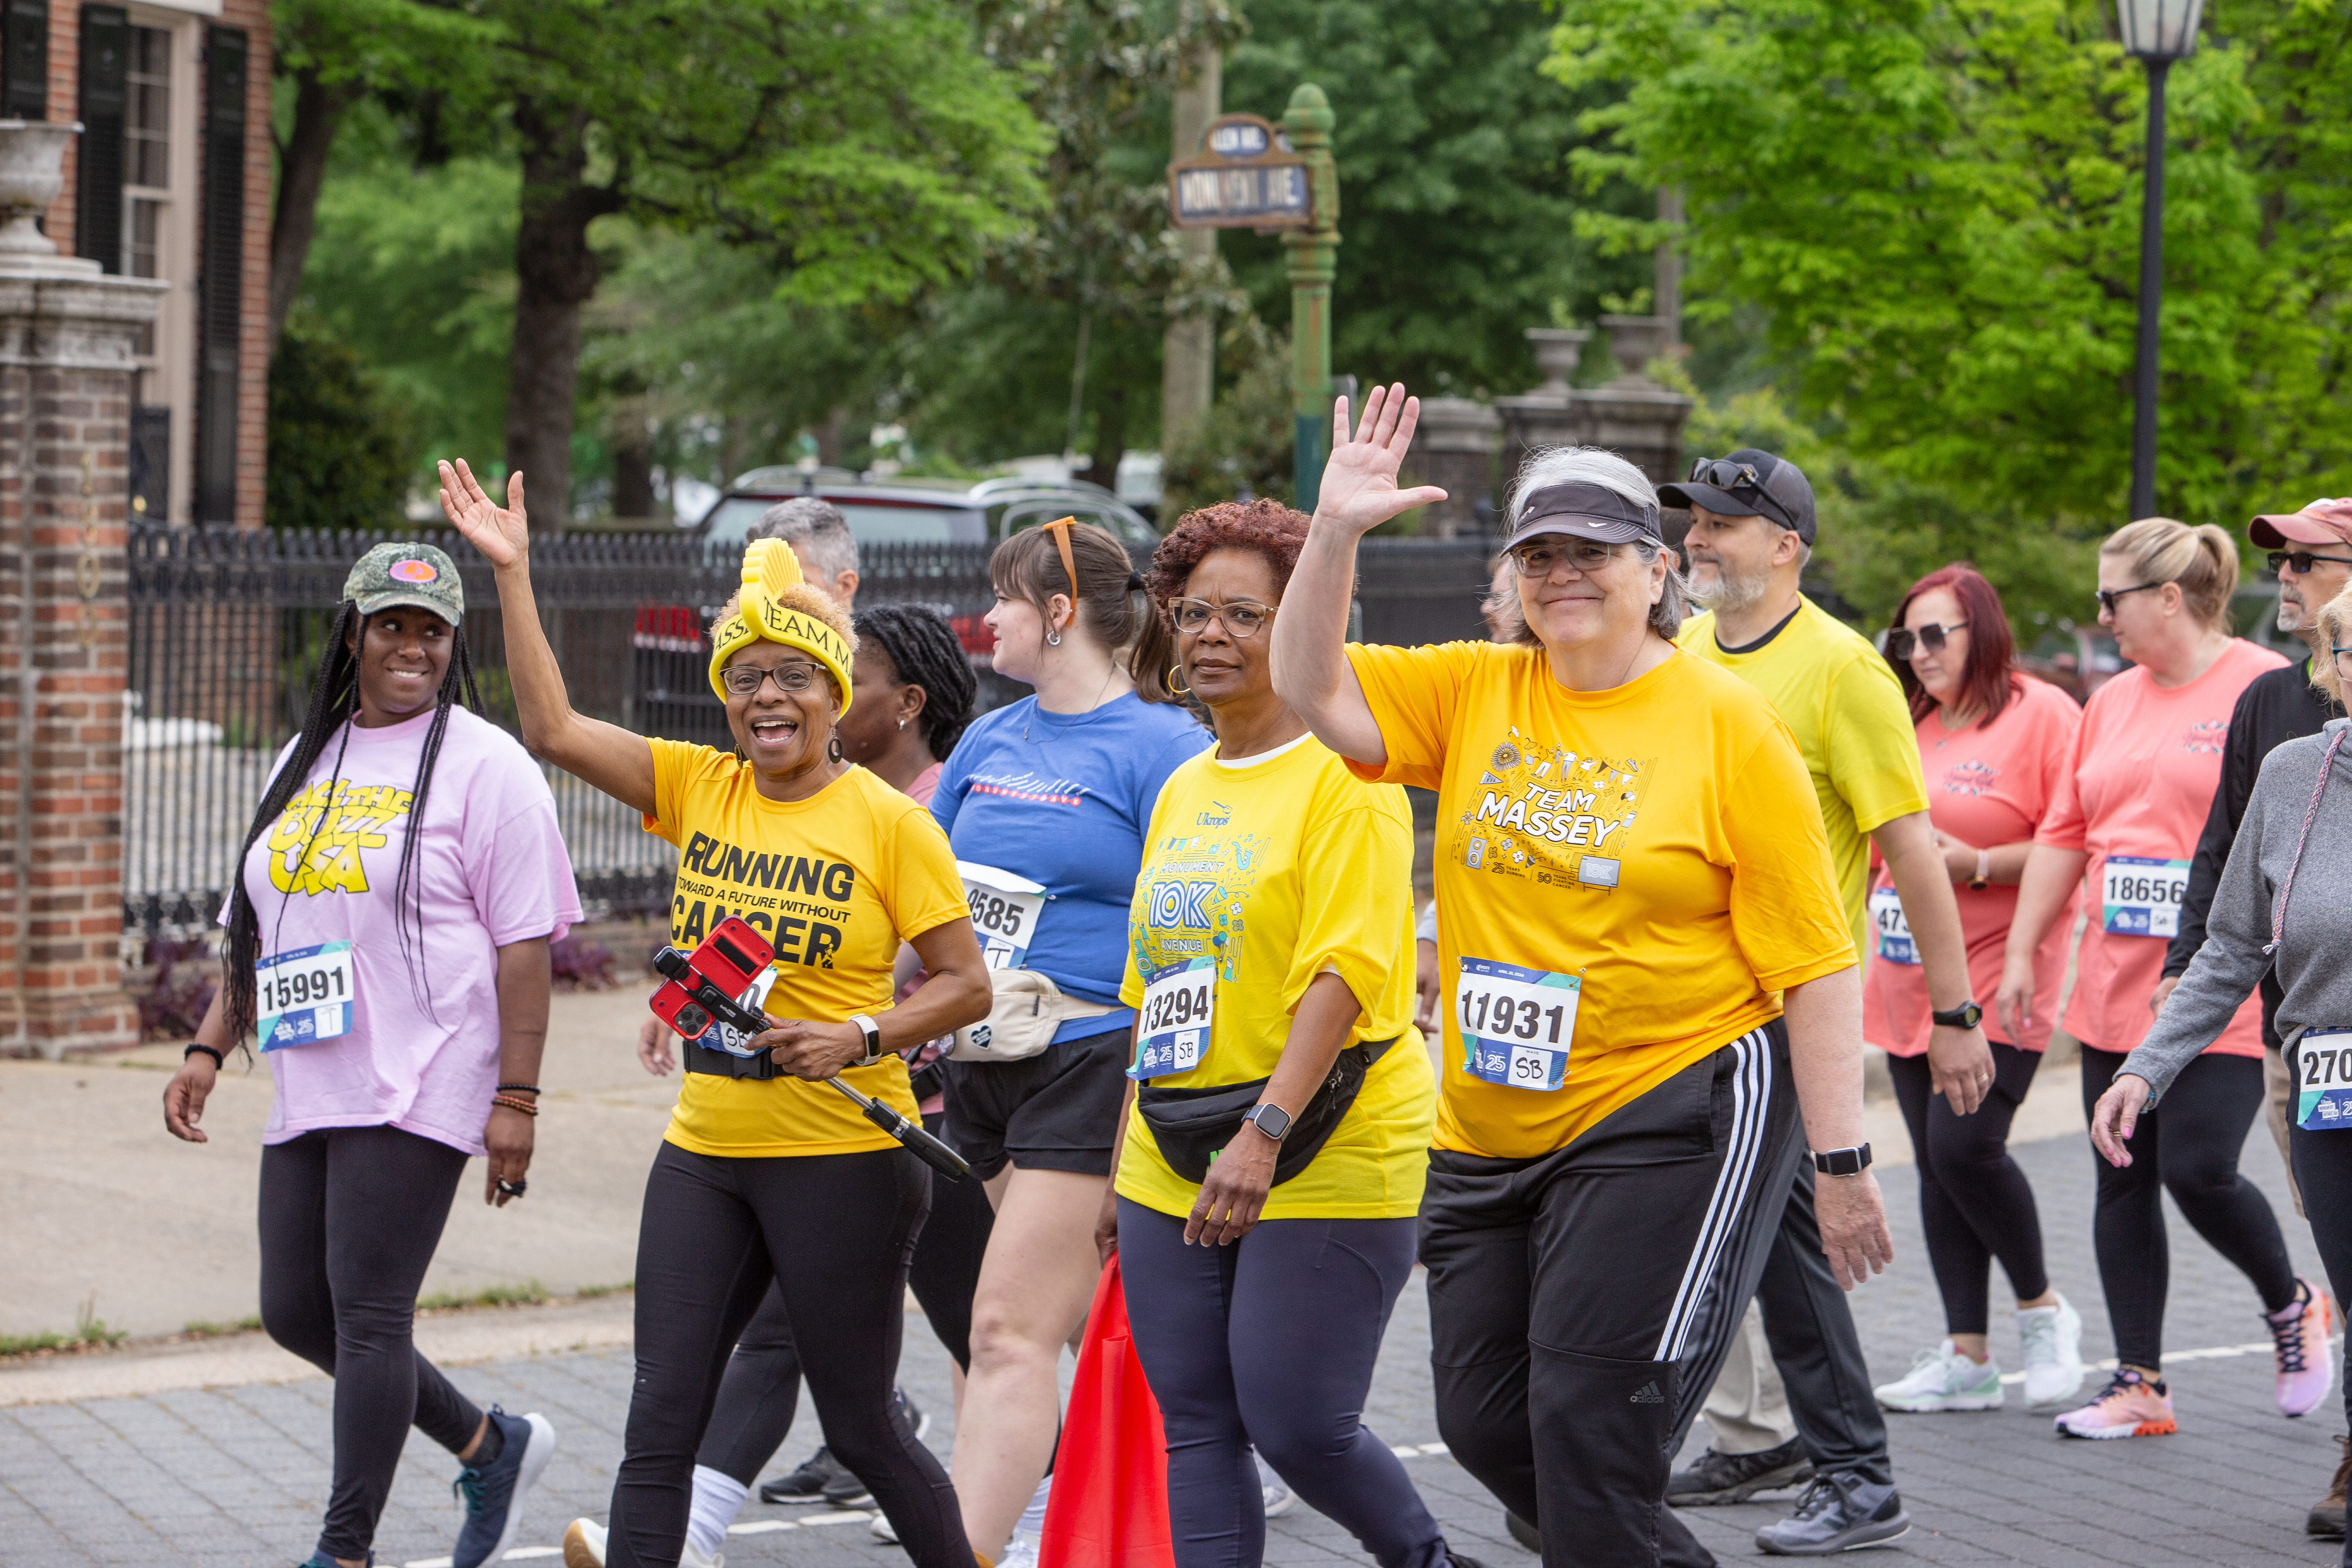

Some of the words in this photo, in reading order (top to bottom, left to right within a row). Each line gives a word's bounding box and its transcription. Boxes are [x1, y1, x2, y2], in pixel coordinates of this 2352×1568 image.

[715, 618, 749, 650] ASS
[764, 596, 829, 652] TEAM
[835, 640, 852, 677] M
[285, 778, 351, 811] ALL
[345, 786, 413, 814] THE
[1525, 782, 1597, 812] TEAM
[268, 805, 398, 852] BUZZ
[1476, 791, 1620, 847] MASSEY
[268, 834, 369, 897] USA
[683, 830, 854, 902] RUNNING
[1159, 861, 1225, 874] MONUMENT
[1491, 862, 1505, 874] 25
[1537, 872, 1552, 884] 50
[1586, 863, 1613, 880] 10K
[679, 876, 714, 897] TOWARD
[715, 889, 726, 900] A
[729, 891, 777, 908] FUTURE
[780, 899, 851, 923] WITHOUT
[1150, 880, 1217, 929] 10K
[2109, 876, 2185, 904] 18656
[1878, 908, 1910, 931] 47
[988, 948, 1010, 969] T
[1161, 938, 1202, 952] AVENUE
[264, 966, 344, 1011] 15991
[1143, 986, 1208, 1034] 13294
[1462, 990, 1564, 1044] 11931
[1159, 1045, 1173, 1062] 25
[1179, 1042, 1193, 1059] SB
[1485, 1054, 1506, 1072] 25
[1516, 1057, 1543, 1079] SB
